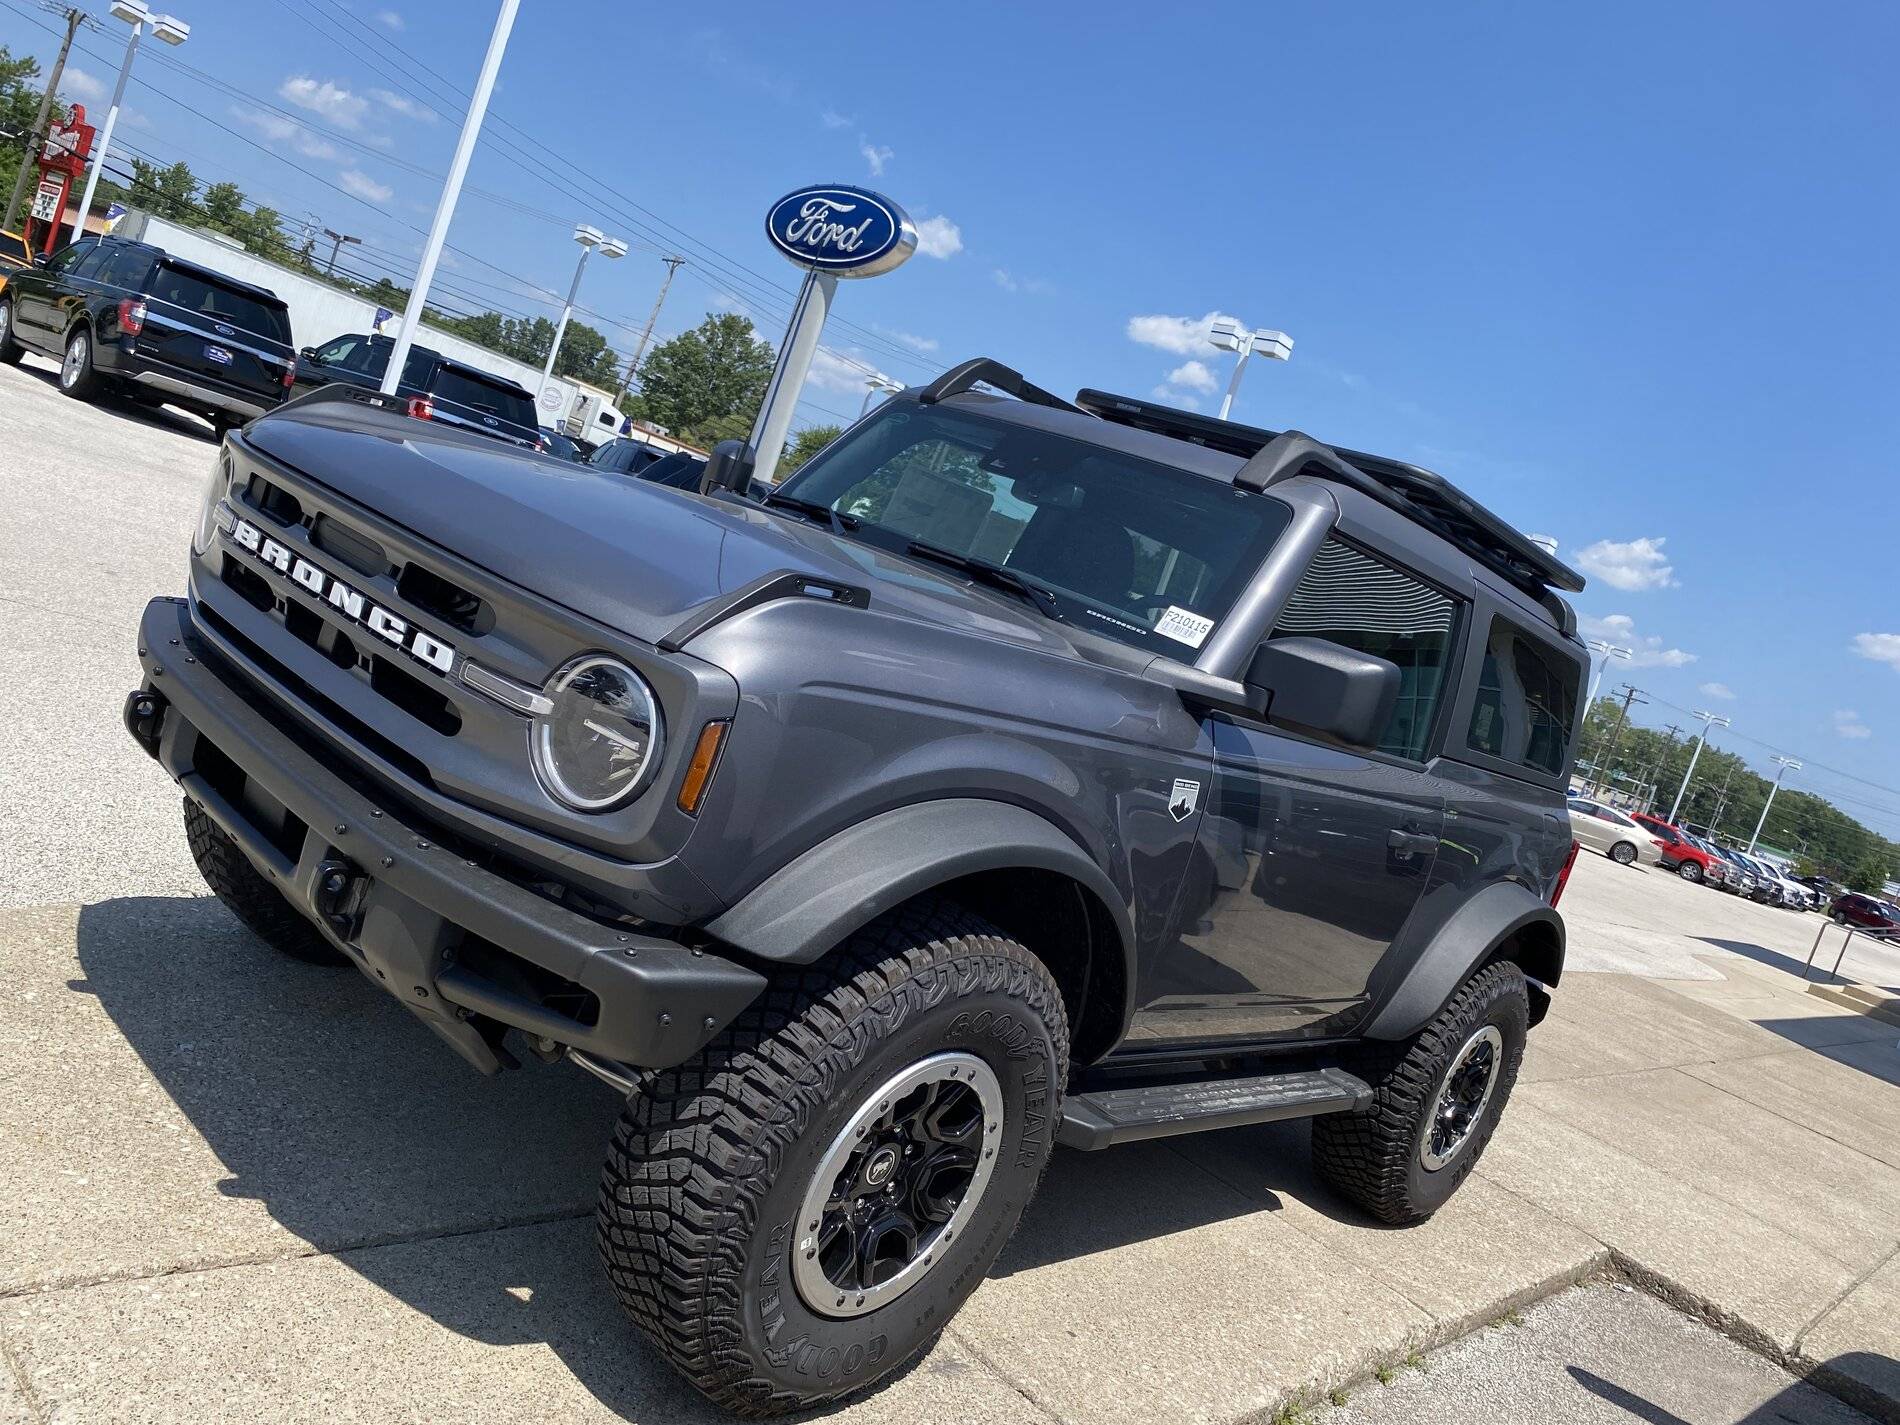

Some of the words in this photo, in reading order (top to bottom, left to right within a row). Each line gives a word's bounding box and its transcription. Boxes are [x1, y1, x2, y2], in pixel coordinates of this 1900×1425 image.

[786, 198, 873, 252] Ford
[234, 520, 455, 674] BRONCO
[1165, 611, 1209, 633] F210115
